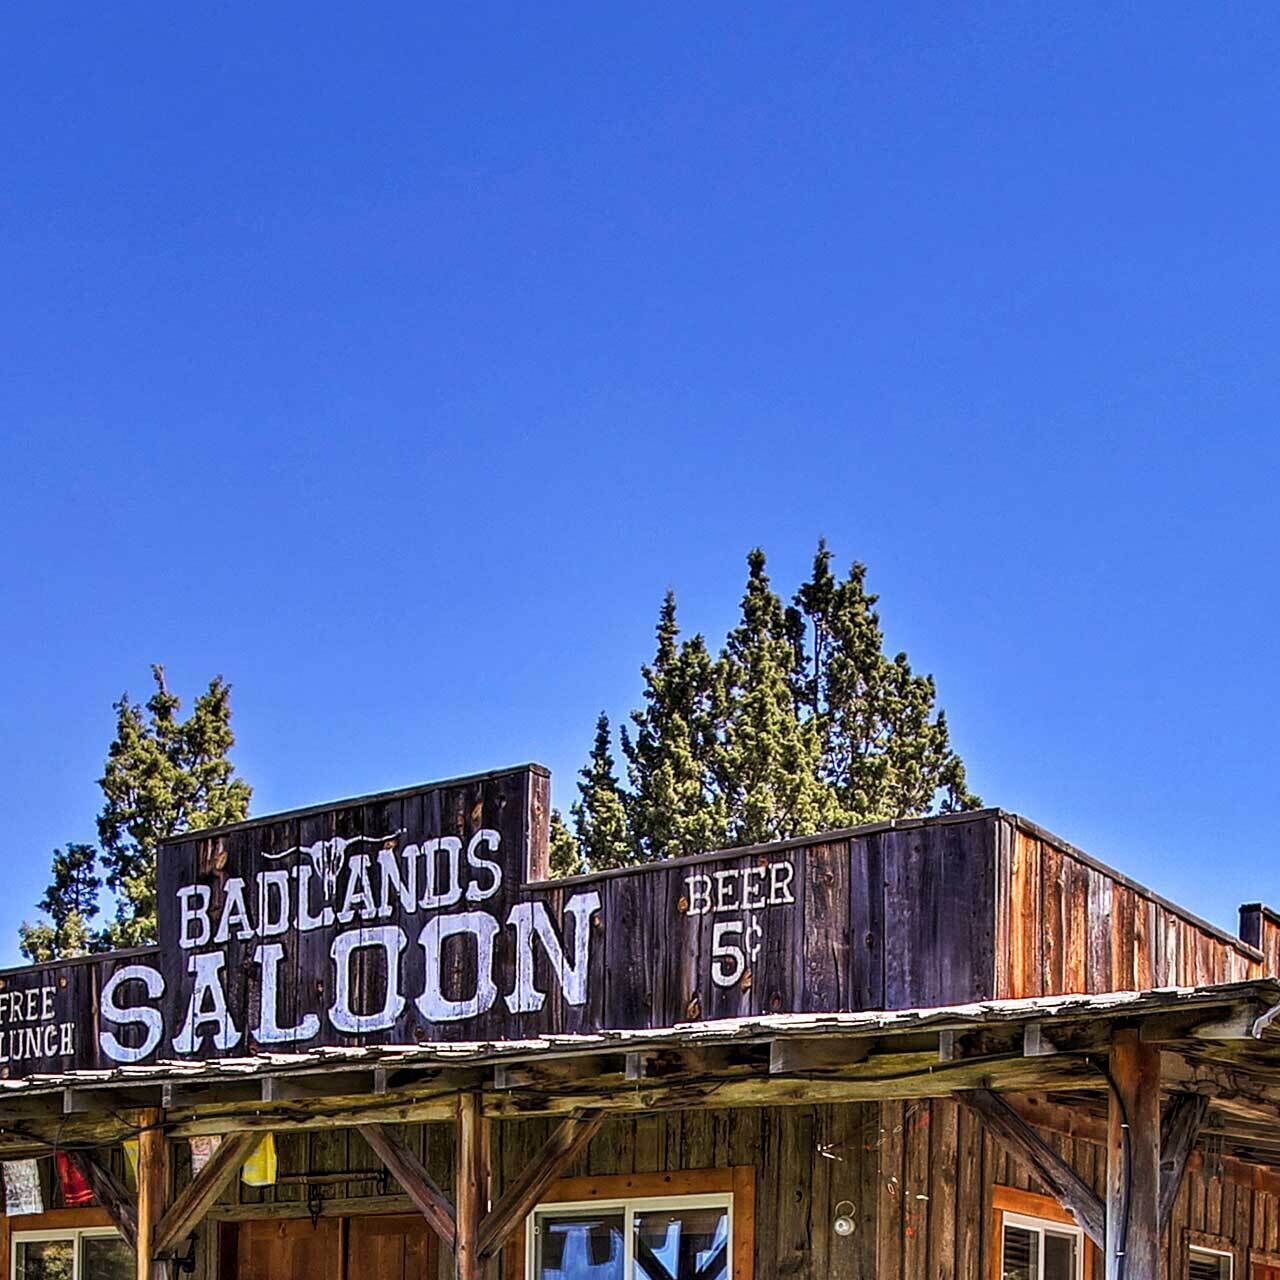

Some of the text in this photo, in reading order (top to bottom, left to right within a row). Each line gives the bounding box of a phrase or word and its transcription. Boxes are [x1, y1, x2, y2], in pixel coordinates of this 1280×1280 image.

[175, 828, 503, 949] BADLANDS
[684, 861, 795, 916] BEER
[99, 891, 601, 1062] SALOON
